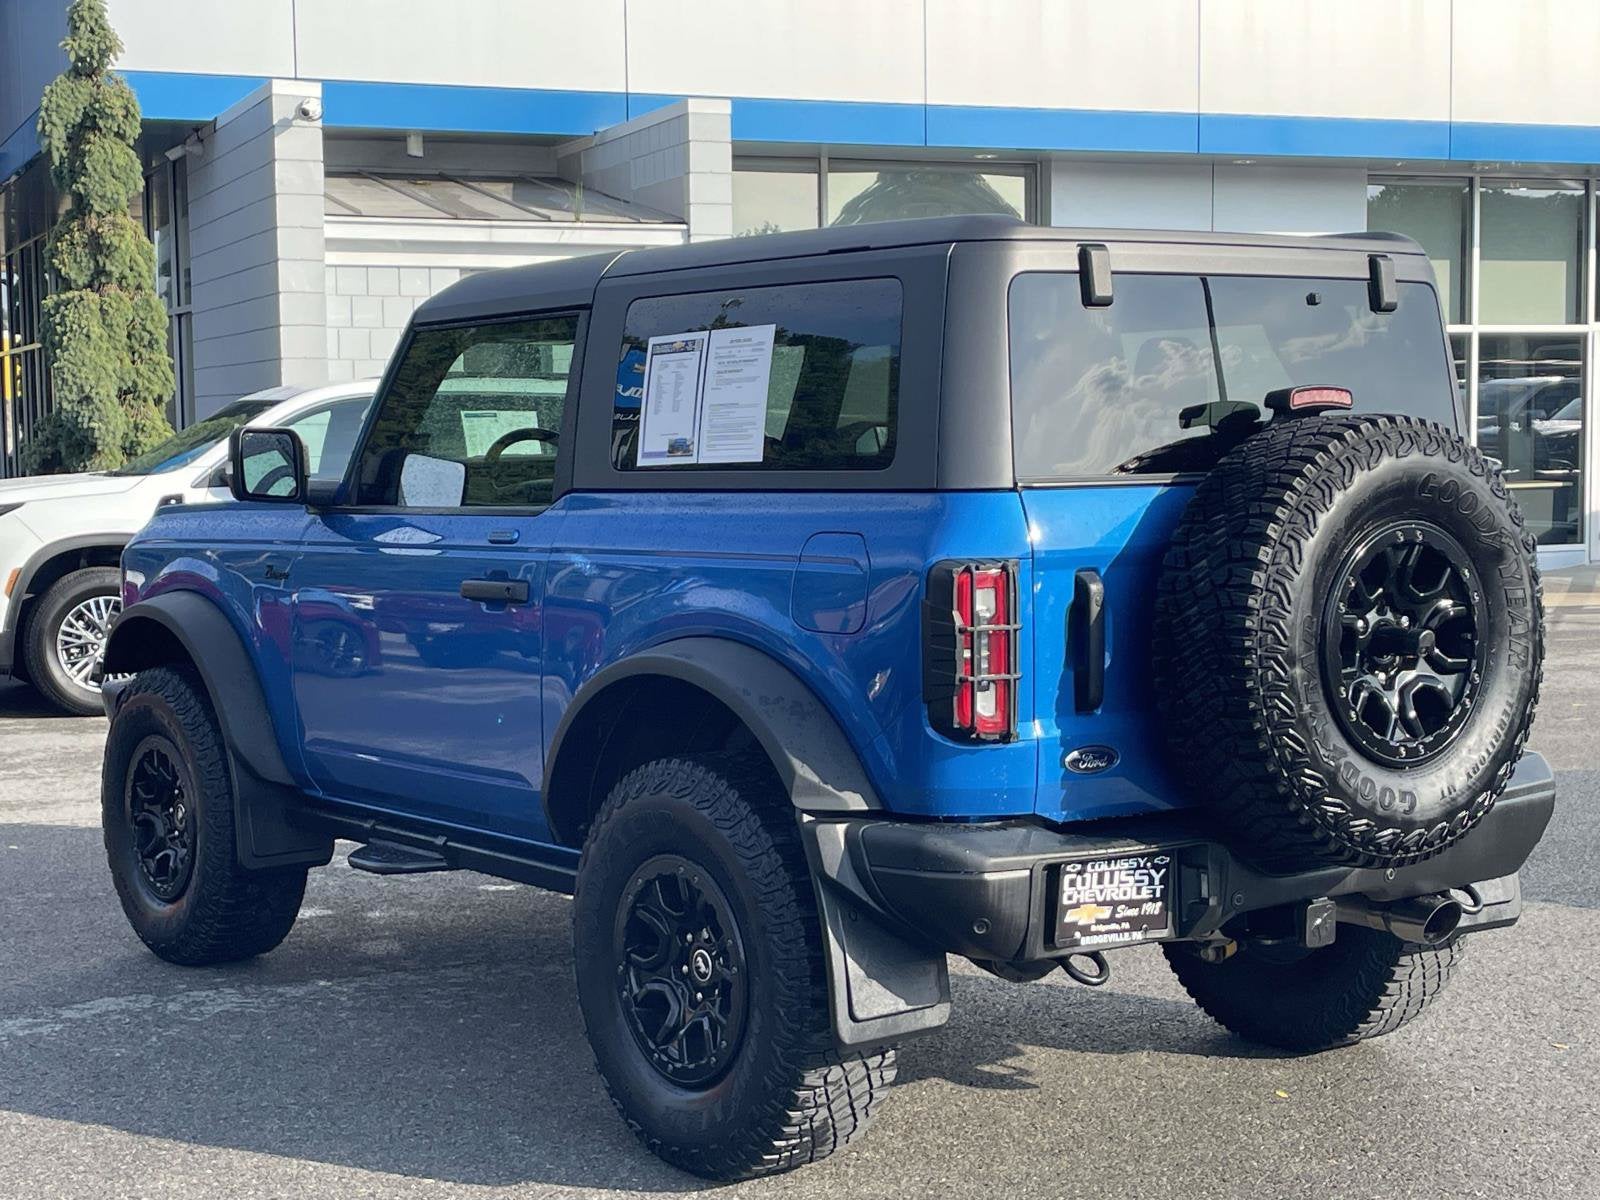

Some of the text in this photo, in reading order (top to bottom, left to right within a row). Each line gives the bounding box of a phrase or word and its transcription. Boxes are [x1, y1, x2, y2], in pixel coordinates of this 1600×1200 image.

[1418, 473, 1531, 671] GOODYEAR
[1466, 700, 1515, 781] TERRITORY
[1079, 753, 1108, 769] Ford
[1063, 868, 1166, 891] COLUSSY
[1062, 885, 1165, 905] CHEVROLET
[1115, 901, 1163, 919] Since 1918
